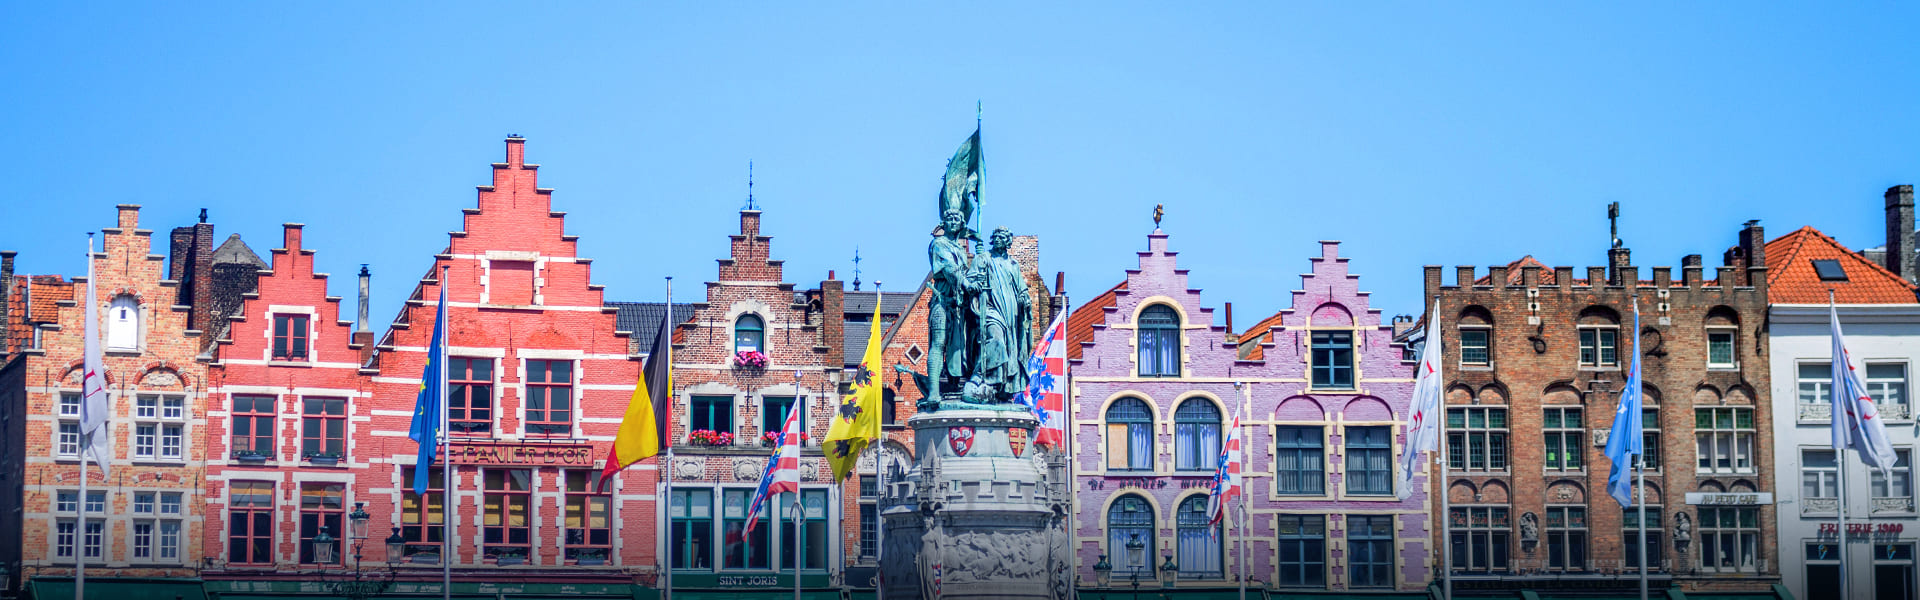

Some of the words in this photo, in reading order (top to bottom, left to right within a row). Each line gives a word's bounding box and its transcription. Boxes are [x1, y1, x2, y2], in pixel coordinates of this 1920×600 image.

[462, 445, 537, 464] PANIER
[544, 446, 590, 464] D'OR
[1876, 523, 1904, 533] 1900
[719, 576, 744, 586] SINT
[746, 576, 778, 586] JORIS
